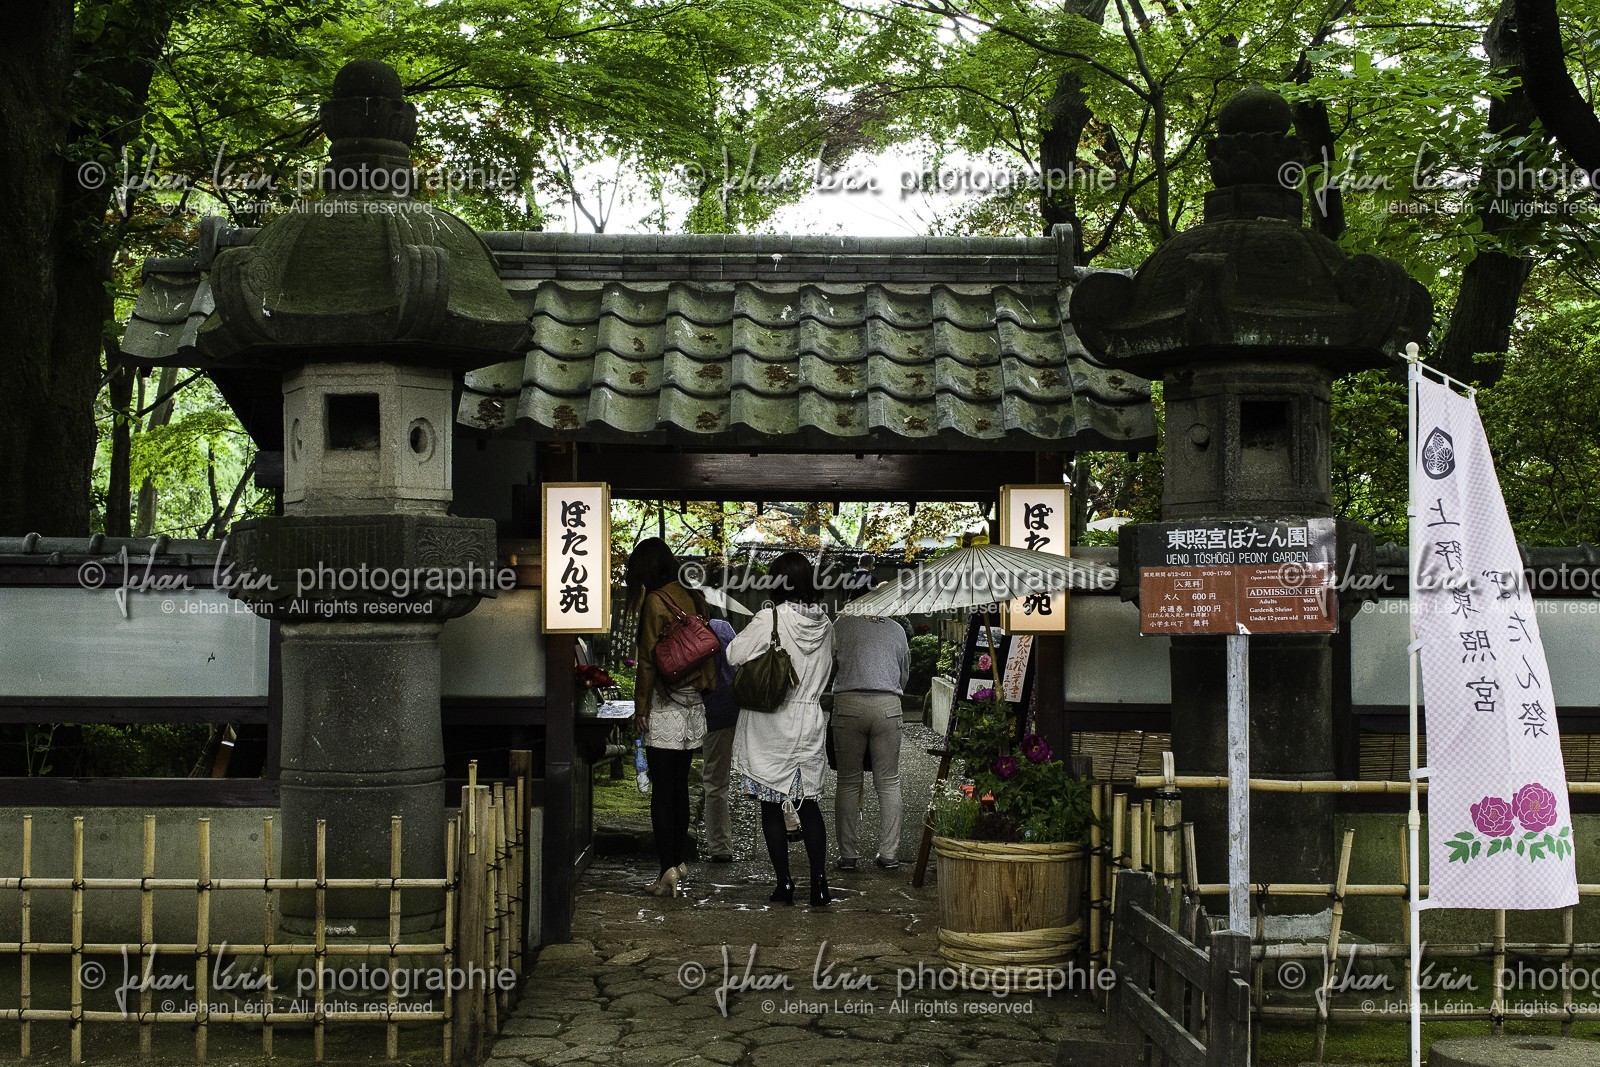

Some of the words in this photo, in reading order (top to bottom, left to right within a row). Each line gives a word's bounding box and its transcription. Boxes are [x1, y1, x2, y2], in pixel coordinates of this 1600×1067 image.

[1166, 526, 1308, 550] 東照宮ぼたん園
[559, 500, 591, 614] ぼたん苑
[1023, 502, 1054, 616] ぼた苑
[1166, 554, 1190, 565] UENO
[1193, 552, 1235, 564] TŌSHŌGŪ
[1238, 552, 1268, 564] PEONY
[1272, 552, 1309, 563] GARDEN
[1175, 580, 1200, 588] 入苑料
[1249, 588, 1303, 596] ADMISSION
[1304, 587, 1321, 595] FEE
[1163, 593, 1180, 601] 大人
[1159, 605, 1183, 613] 共通券
[1149, 620, 1184, 628] 小学生以下
[1193, 619, 1209, 627] 無料
